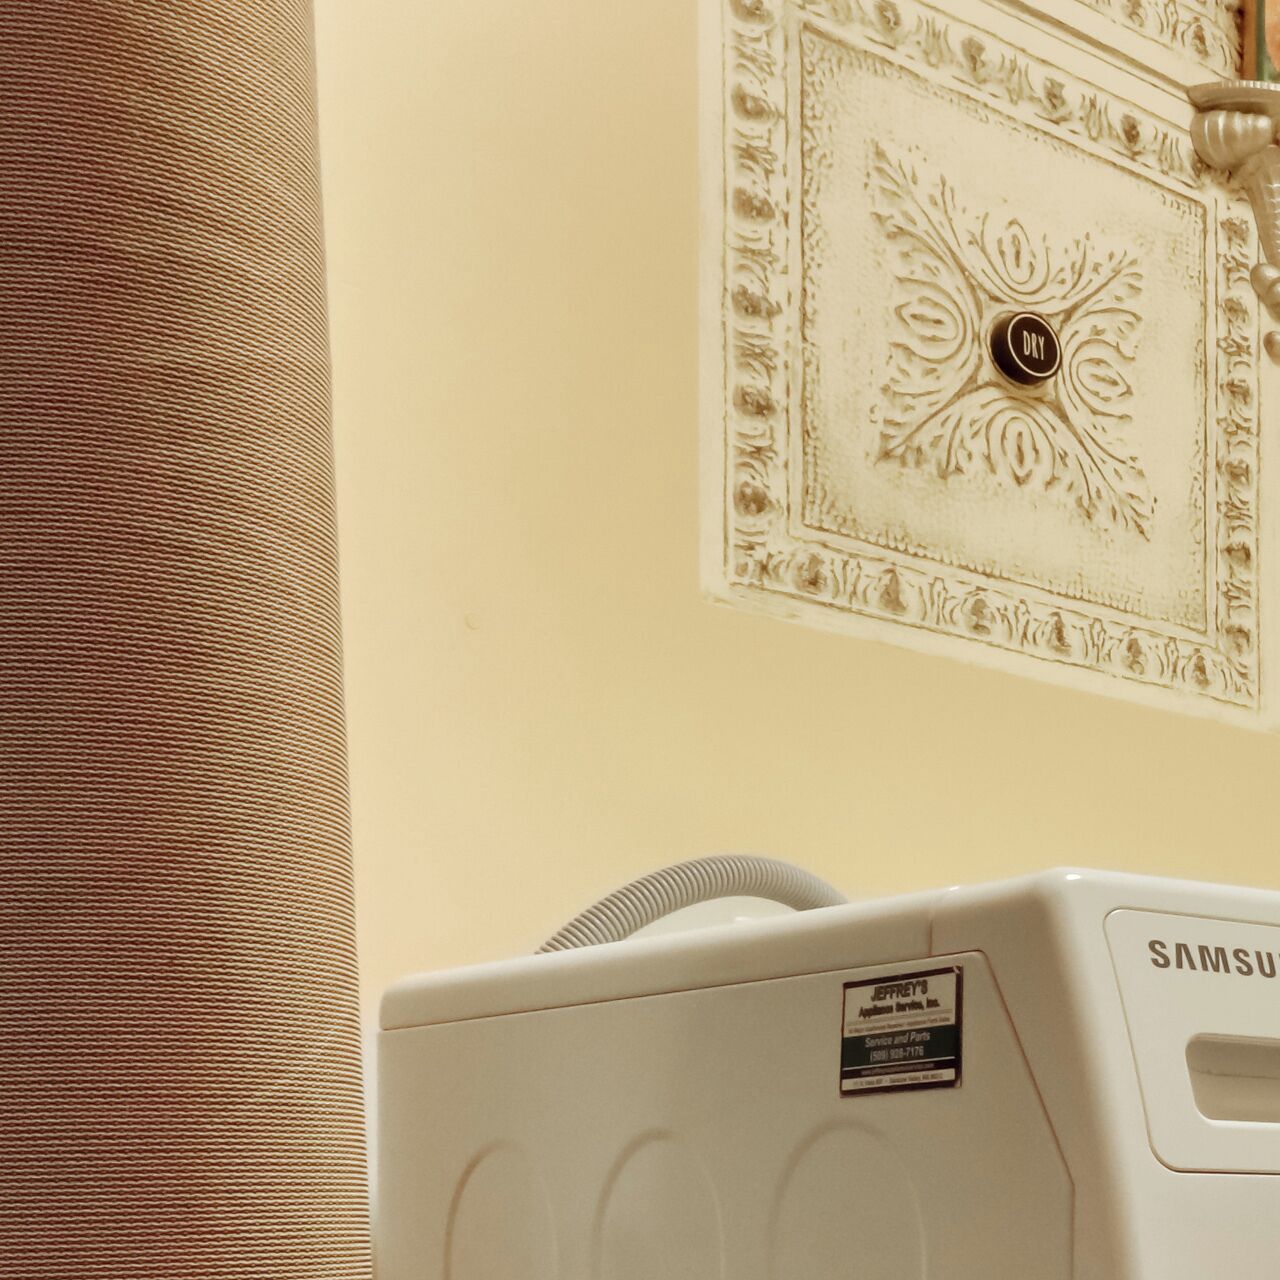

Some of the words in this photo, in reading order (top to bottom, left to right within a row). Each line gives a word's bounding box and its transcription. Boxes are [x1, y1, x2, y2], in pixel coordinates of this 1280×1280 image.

[1022, 330, 1045, 361] DRY
[871, 979, 928, 1002] JEFFREY'S
[865, 1036, 893, 1048] Service
[893, 1033, 909, 1044] and
[909, 1031, 931, 1043] Parts
